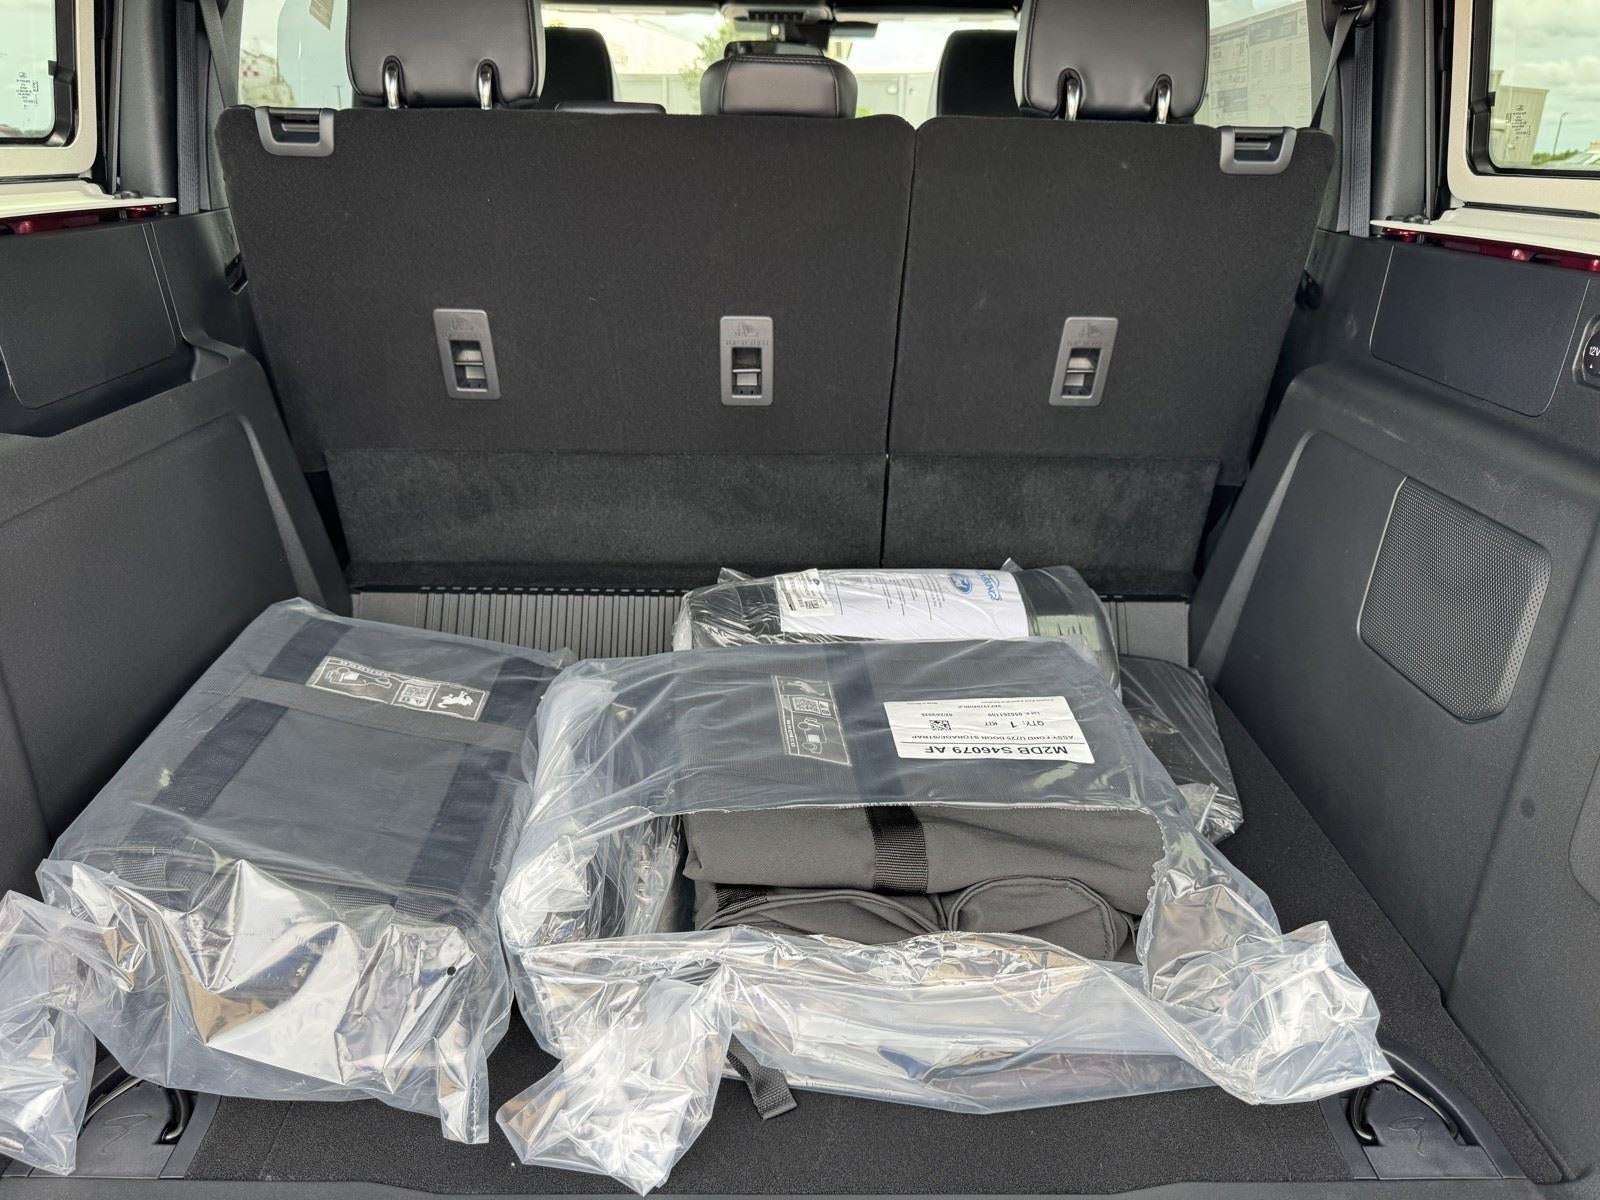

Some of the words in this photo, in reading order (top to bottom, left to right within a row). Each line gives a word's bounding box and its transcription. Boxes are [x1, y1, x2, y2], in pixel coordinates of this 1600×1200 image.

[925, 746, 946, 754] AF
[952, 746, 1013, 754] S46079
[1017, 745, 1068, 755] M2DB
